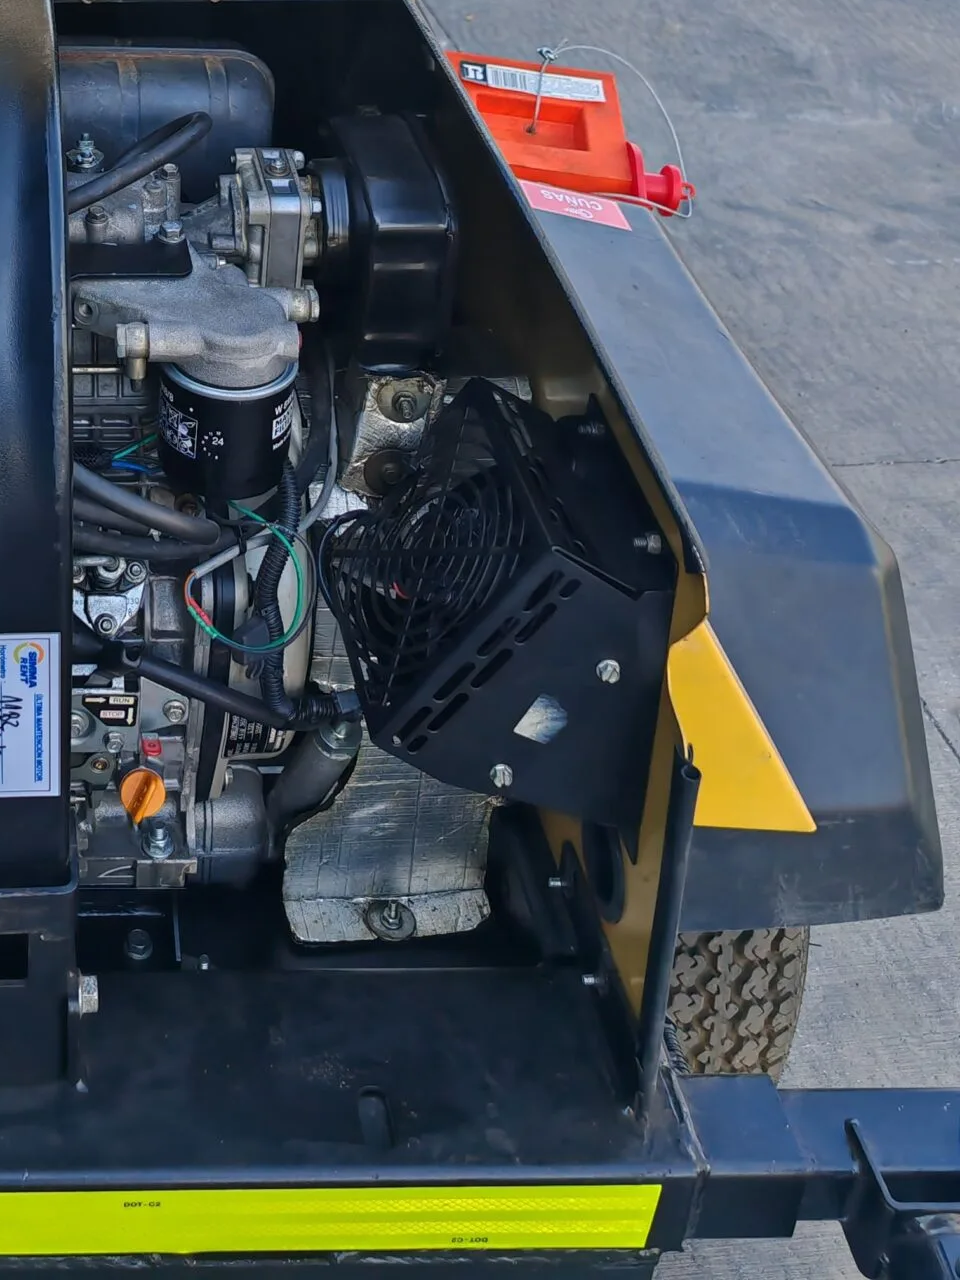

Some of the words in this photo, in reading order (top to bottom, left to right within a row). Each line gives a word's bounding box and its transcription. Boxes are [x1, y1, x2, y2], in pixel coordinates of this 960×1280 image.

[541, 189, 603, 211] CUÑAS
[212, 436, 224, 446] 24
[20, 657, 28, 684] RENT
[28, 651, 38, 688] SIMMA
[35, 717, 44, 758] MANTENCIÓN
[35, 759, 44, 781] MOTOR
